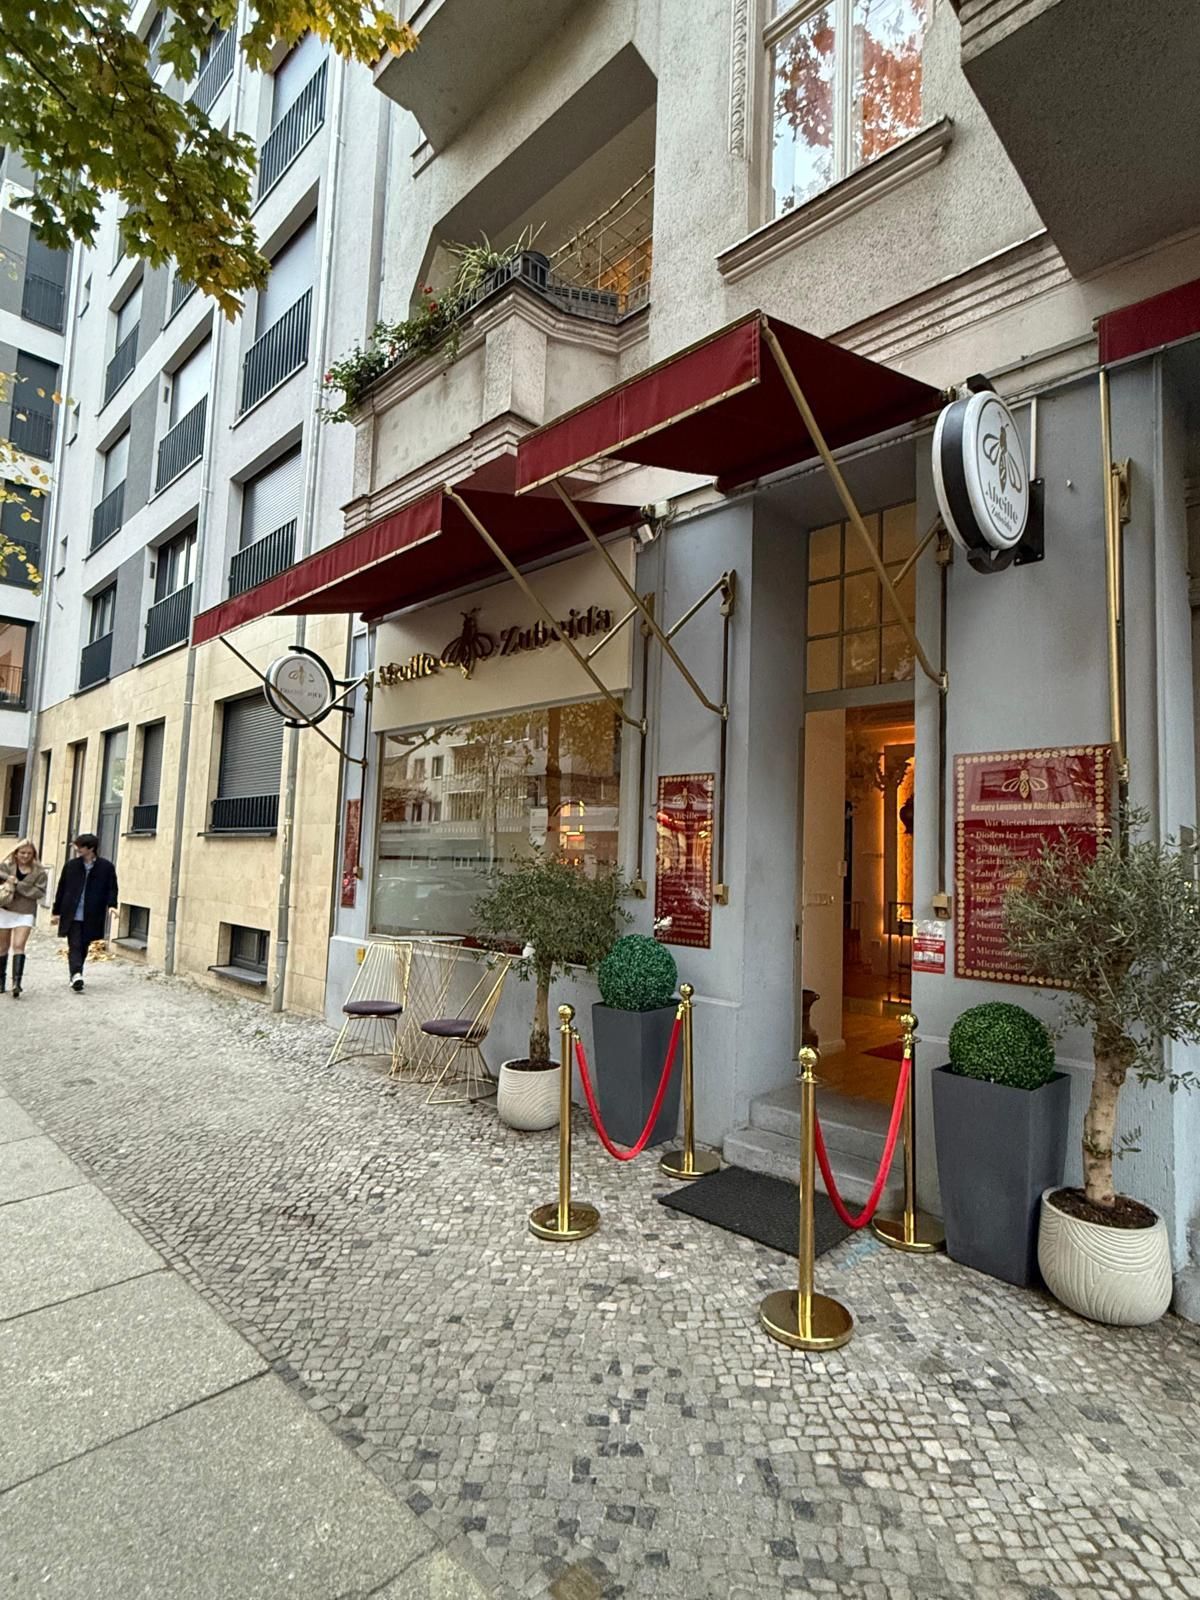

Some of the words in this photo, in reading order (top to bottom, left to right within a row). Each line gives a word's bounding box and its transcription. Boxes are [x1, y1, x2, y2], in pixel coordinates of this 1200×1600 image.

[985, 480, 1018, 524] Abeille
[971, 803, 995, 812] Beauty
[996, 803, 1021, 811] Lounge
[1023, 802, 1032, 810] by
[984, 819, 999, 827] Wir
[976, 830, 1005, 839] Dioden
[1006, 830, 1019, 839] Ice
[1020, 830, 1044, 839] Laser
